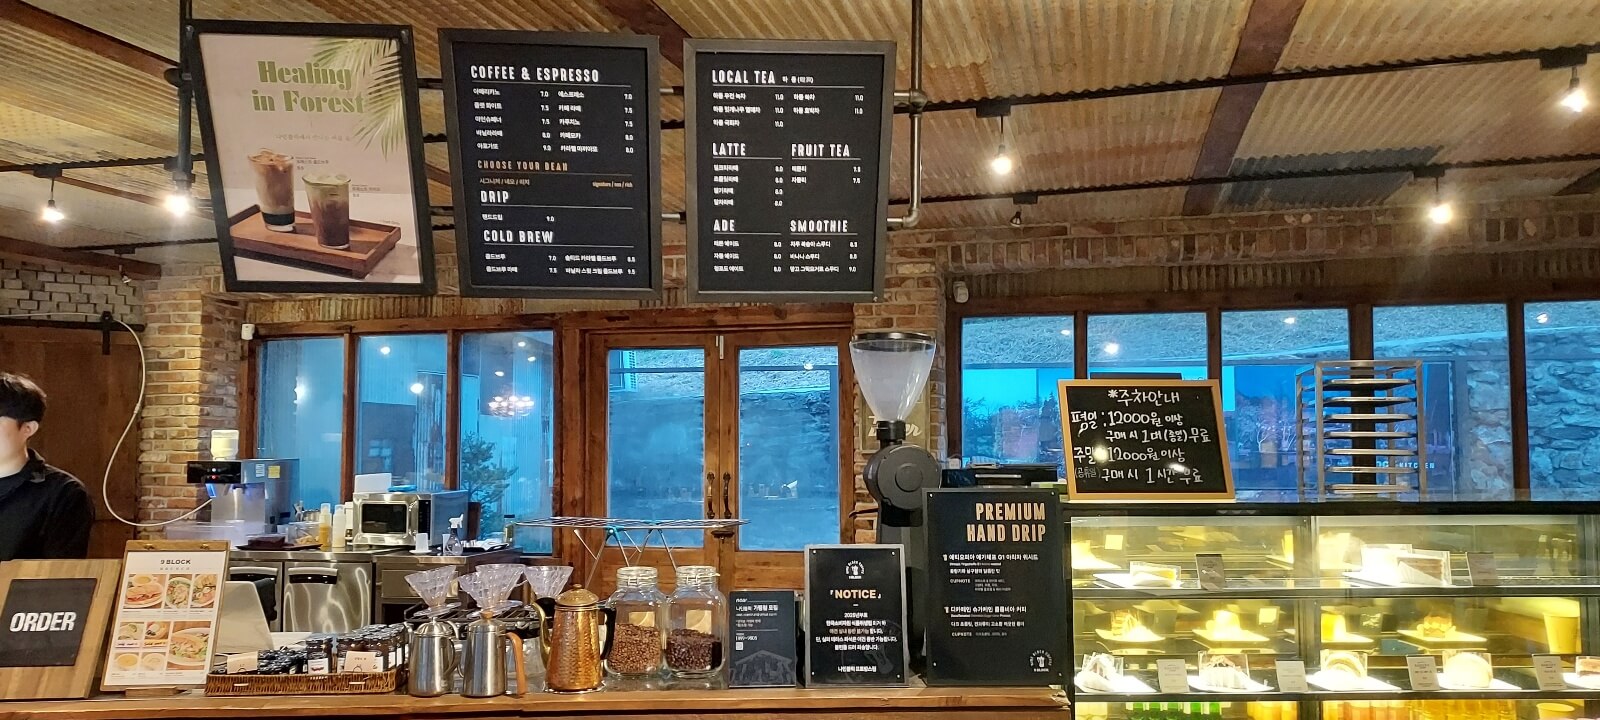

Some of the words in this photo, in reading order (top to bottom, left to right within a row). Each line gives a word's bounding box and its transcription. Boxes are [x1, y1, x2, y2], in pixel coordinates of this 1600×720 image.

[258, 61, 352, 90] Healing
[471, 65, 514, 80] COFFEE
[522, 67, 530, 81] &
[537, 68, 599, 82] ESPRESSO
[712, 70, 749, 84] LOCAL
[754, 70, 776, 84] TEA
[473, 88, 500, 96] 아메리카노
[252, 90, 275, 111] in
[283, 90, 365, 113] Forest
[713, 143, 746, 156] LATTE
[791, 144, 825, 157] FRUIT
[829, 144, 850, 157] TEA
[478, 160, 512, 170] CHOOSE
[517, 161, 540, 170] YOUR
[544, 162, 568, 171] BEAN
[480, 190, 509, 203] DRIP
[714, 220, 735, 232] ADE
[790, 220, 848, 232] SMOOTHIE
[483, 230, 513, 242] COLD
[519, 230, 553, 243] BREW
[1071, 411, 1098, 437] 평일
[1165, 414, 1183, 426] 이상
[1105, 430, 1127, 443] 구매
[1128, 430, 1138, 440] 시
[1189, 428, 1211, 443] 무료
[1161, 448, 1187, 463] 이상
[1101, 468, 1124, 481] 구매
[1128, 469, 1139, 480] 시
[976, 503, 1046, 521] PREMIUM
[966, 524, 1005, 542] HAND
[1012, 525, 1046, 542] DRIP
[10, 612, 77, 632] ORDER
